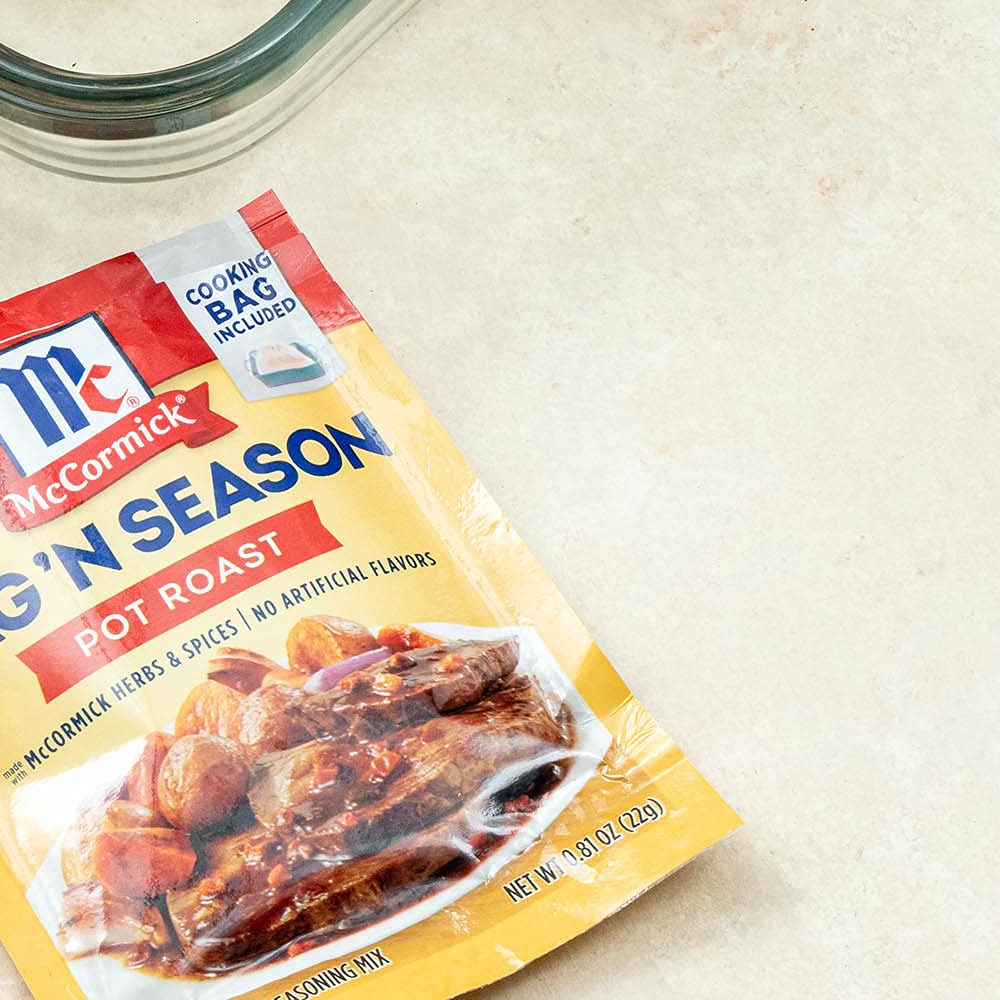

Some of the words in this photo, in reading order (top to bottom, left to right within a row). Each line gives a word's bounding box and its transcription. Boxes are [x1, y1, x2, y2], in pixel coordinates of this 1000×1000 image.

[186, 251, 272, 305] COOKING
[205, 277, 277, 325] BAG
[213, 297, 296, 344] INCLUDED
[2, 402, 197, 518] McCormick
[119, 412, 392, 552] SEASON
[73, 598, 149, 656] POT
[158, 531, 284, 610] ROAST
[24, 693, 112, 770] McCORMICK
[110, 658, 166, 701] HERBS
[165, 650, 183, 668] &
[182, 619, 238, 659] SPICES
[251, 600, 278, 623] NO
[281, 564, 368, 609] ARTIFICIAL
[368, 551, 438, 577] FLAVORS
[2, 760, 24, 780] made
[11, 769, 29, 786] with
[503, 873, 539, 903] NET
[534, 856, 566, 884] WT
[561, 837, 599, 867] 0.81
[595, 823, 621, 846] OZ
[618, 798, 665, 833] (22g)
[274, 963, 358, 1000] ASONING
[352, 948, 391, 974] MIX
